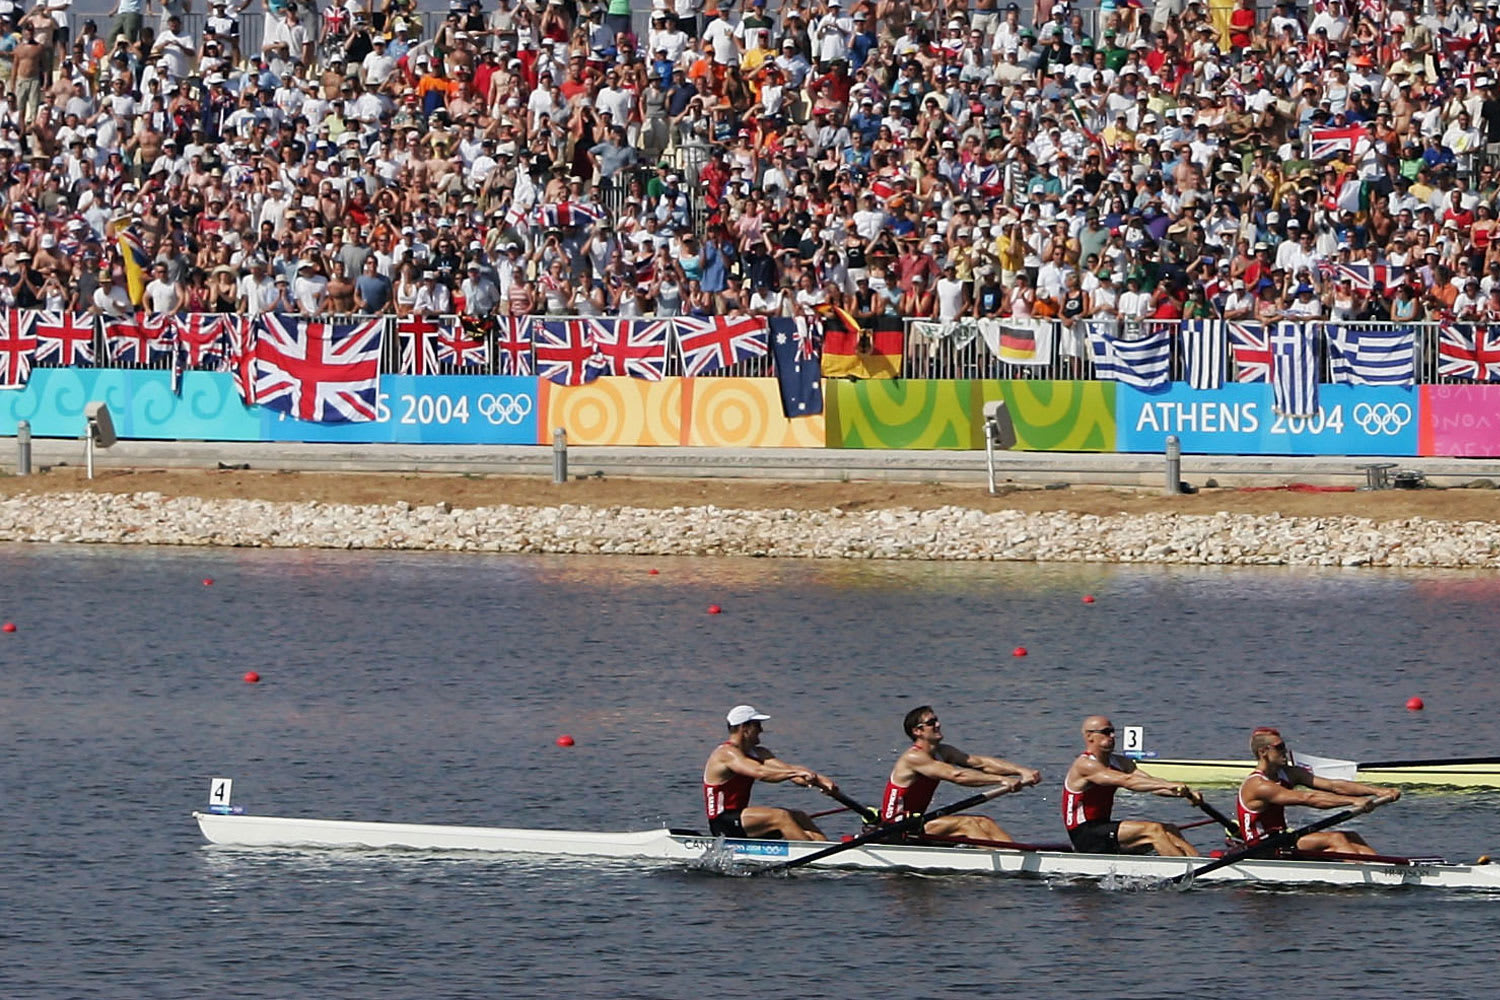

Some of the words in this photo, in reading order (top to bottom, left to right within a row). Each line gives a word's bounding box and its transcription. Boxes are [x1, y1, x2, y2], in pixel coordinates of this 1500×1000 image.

[400, 394, 470, 424] 2004
[1135, 402, 1259, 433] ATHENS
[1128, 730, 1137, 748] 3
[214, 781, 225, 801] 4
